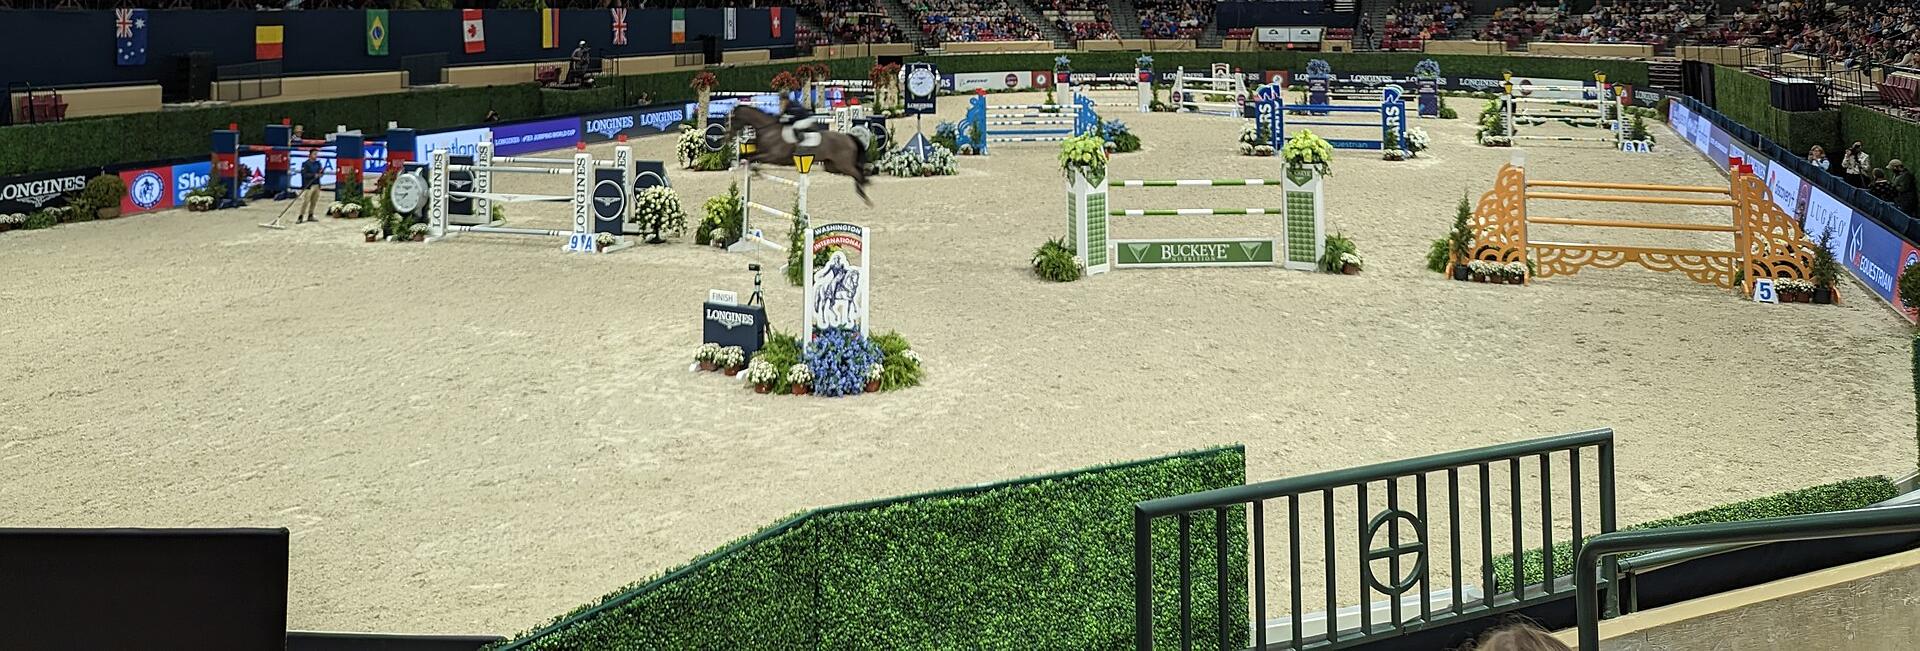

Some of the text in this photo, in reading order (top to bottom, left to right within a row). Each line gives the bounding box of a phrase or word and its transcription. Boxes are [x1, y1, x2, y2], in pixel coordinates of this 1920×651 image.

[1459, 78, 1499, 87] LONGINES
[587, 116, 634, 133] LONGINES
[640, 110, 683, 126] LONGINES
[432, 153, 443, 228] LONGINES
[576, 157, 586, 234] LONGINES
[815, 224, 862, 235] WASHINGTON
[813, 236, 862, 251] INTERNATIONAL
[1161, 243, 1228, 260] BUCKEYE
[711, 292, 735, 302] FINISH
[1760, 282, 1771, 300] 5
[706, 308, 754, 326] LONGINES
